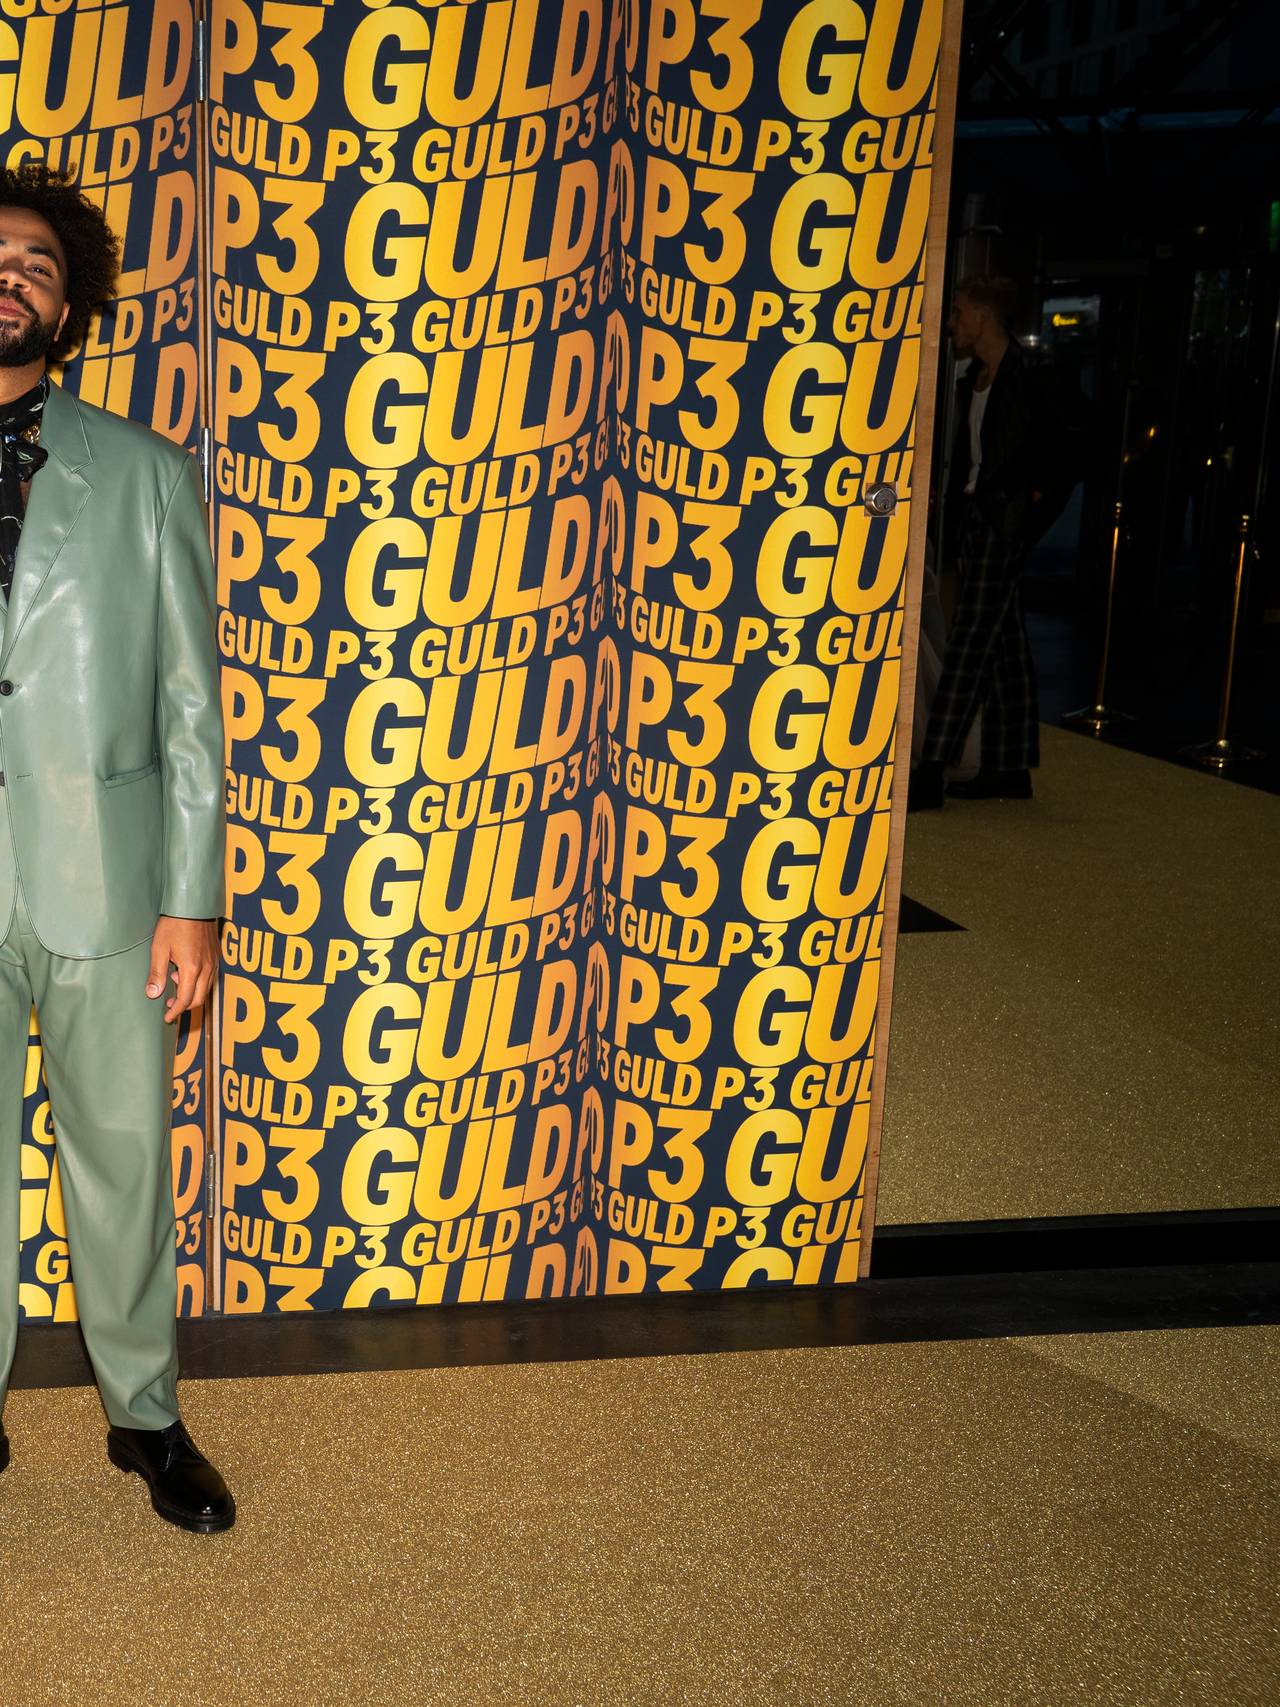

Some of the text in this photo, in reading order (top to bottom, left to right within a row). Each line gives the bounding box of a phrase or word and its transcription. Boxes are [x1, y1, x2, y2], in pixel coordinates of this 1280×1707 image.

[209, 0, 603, 130] P3 GULD
[645, 0, 944, 120] P3 GU
[149, 105, 192, 171] P3
[211, 95, 599, 184] GULD P3 GULD P3
[645, 95, 743, 166] GULD
[752, 119, 830, 175] P3
[212, 166, 327, 295] P3
[343, 159, 599, 302] GULD
[639, 155, 756, 285] P3
[769, 167, 933, 292] GU
[152, 278, 194, 342] P3
[214, 267, 595, 354] GULD P3 GULD P3
[640, 268, 737, 336] GULD
[745, 290, 822, 344] P3
[214, 338, 327, 463] P3
[344, 329, 595, 469] GULD
[635, 326, 749, 451] P3
[762, 337, 921, 457] GU
[216, 434, 591, 520] GULD P3 GULD P3
[635, 434, 730, 500] GULD
[738, 456, 813, 508] P3
[216, 504, 328, 625] P3
[344, 494, 591, 630] GULD
[630, 490, 742, 612] P3
[755, 500, 911, 617] GU
[217, 596, 587, 680] GULD P3 GULD P3
[631, 596, 724, 660] GULD
[732, 616, 805, 666] P3
[220, 665, 328, 783] P3
[344, 655, 587, 787] GULD
[625, 650, 736, 767] P3
[748, 658, 902, 772] GU
[224, 751, 583, 835] GULD P3 GULD P3
[625, 752, 717, 814] GULD
[725, 771, 797, 820] P3
[223, 823, 328, 935] P3
[343, 809, 583, 939] GULD
[620, 805, 728, 917] P3
[740, 811, 891, 922] GU
[220, 903, 578, 985] GULD P3 GULD P3
[620, 904, 710, 962] GULD
[717, 921, 789, 968] P3
[221, 973, 327, 1082] P3
[342, 959, 578, 1085] GULD
[614, 955, 721, 1063] P3
[733, 959, 881, 1067] GU
[222, 1049, 573, 1130] GULD P3 GULD P3
[614, 1050, 703, 1106] GULD
[710, 1066, 780, 1111] P3
[222, 1119, 326, 1223] P3
[341, 1103, 573, 1226] GULD
[608, 1098, 714, 1203] P3
[725, 1103, 871, 1206] GU
[223, 1190, 568, 1269] GULD P3 GULD P3
[608, 1191, 695, 1245] GULD
[703, 1206, 772, 1249] P3
